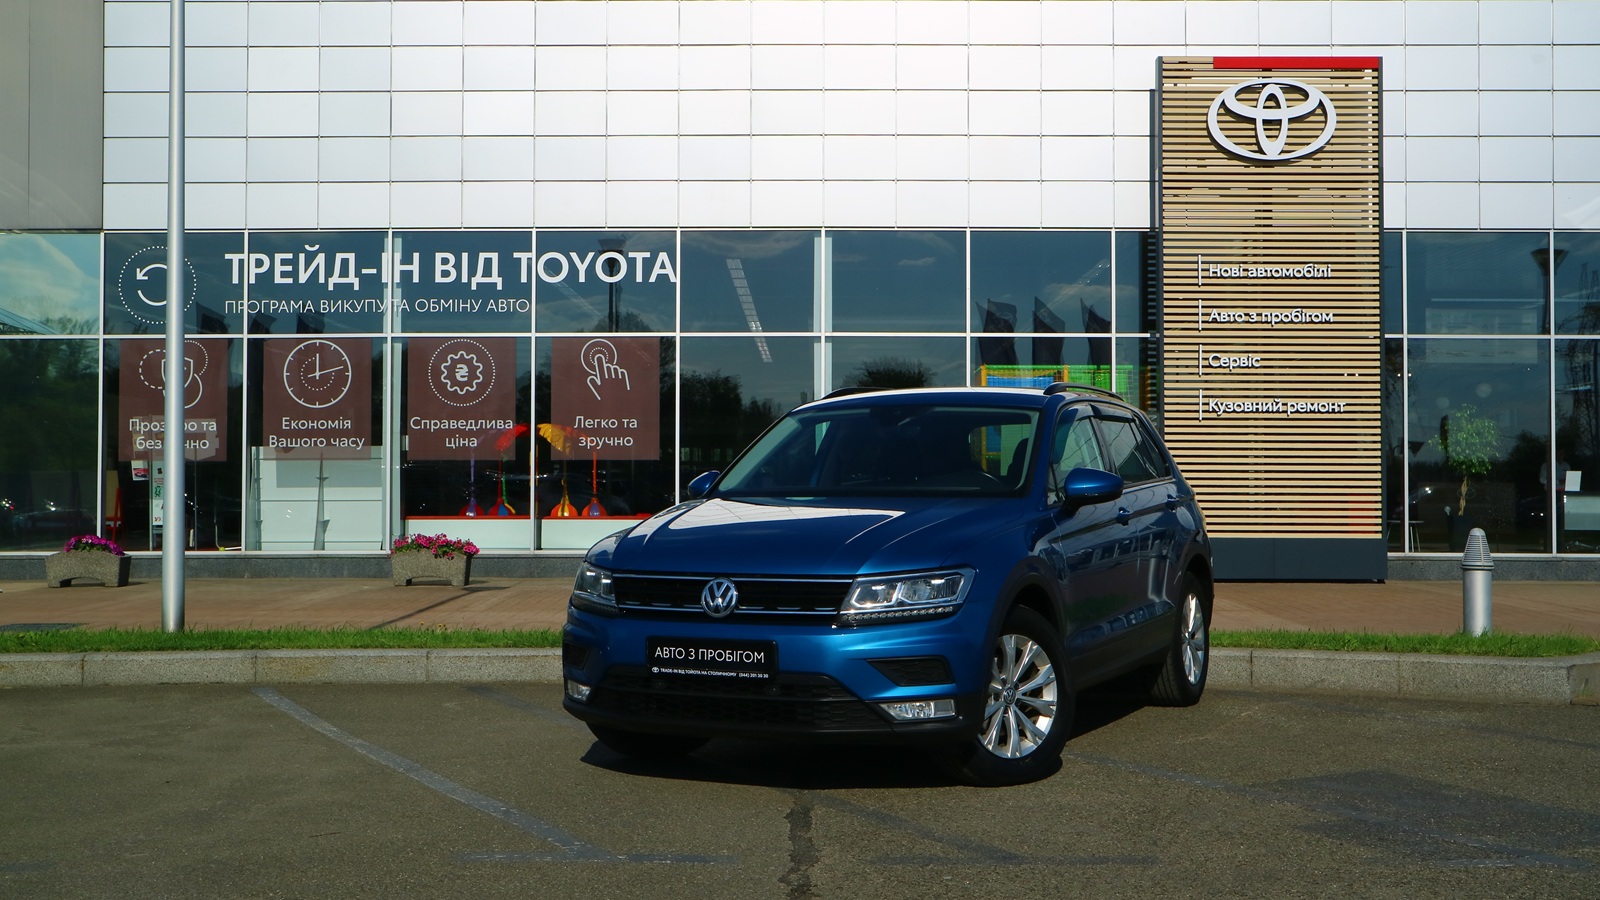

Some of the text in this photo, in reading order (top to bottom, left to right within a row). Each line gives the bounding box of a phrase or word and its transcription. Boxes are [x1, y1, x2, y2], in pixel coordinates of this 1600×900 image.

[224, 244, 677, 291] ТРЕЙД-ІН ВІД TOYOTA
[1208, 263, 1332, 278] Нові автомобілі
[225, 299, 530, 314] ПРОГРАМА ВИКУПУ ТА ОБМІНУ АВТО
[1208, 308, 1334, 326] Авто з пробігом
[1208, 353, 1261, 371] Сервіс
[1208, 398, 1346, 416] Кузовний ремонт
[129, 418, 218, 435] Прозо та
[282, 416, 352, 430] Економія
[410, 416, 514, 432] Справедлива
[573, 415, 638, 429] Легко та
[269, 435, 365, 450] Вашого часу
[445, 434, 478, 449] ціна
[578, 436, 634, 450] зручно
[654, 646, 765, 664] АВТО З ПРОБІГОМ
